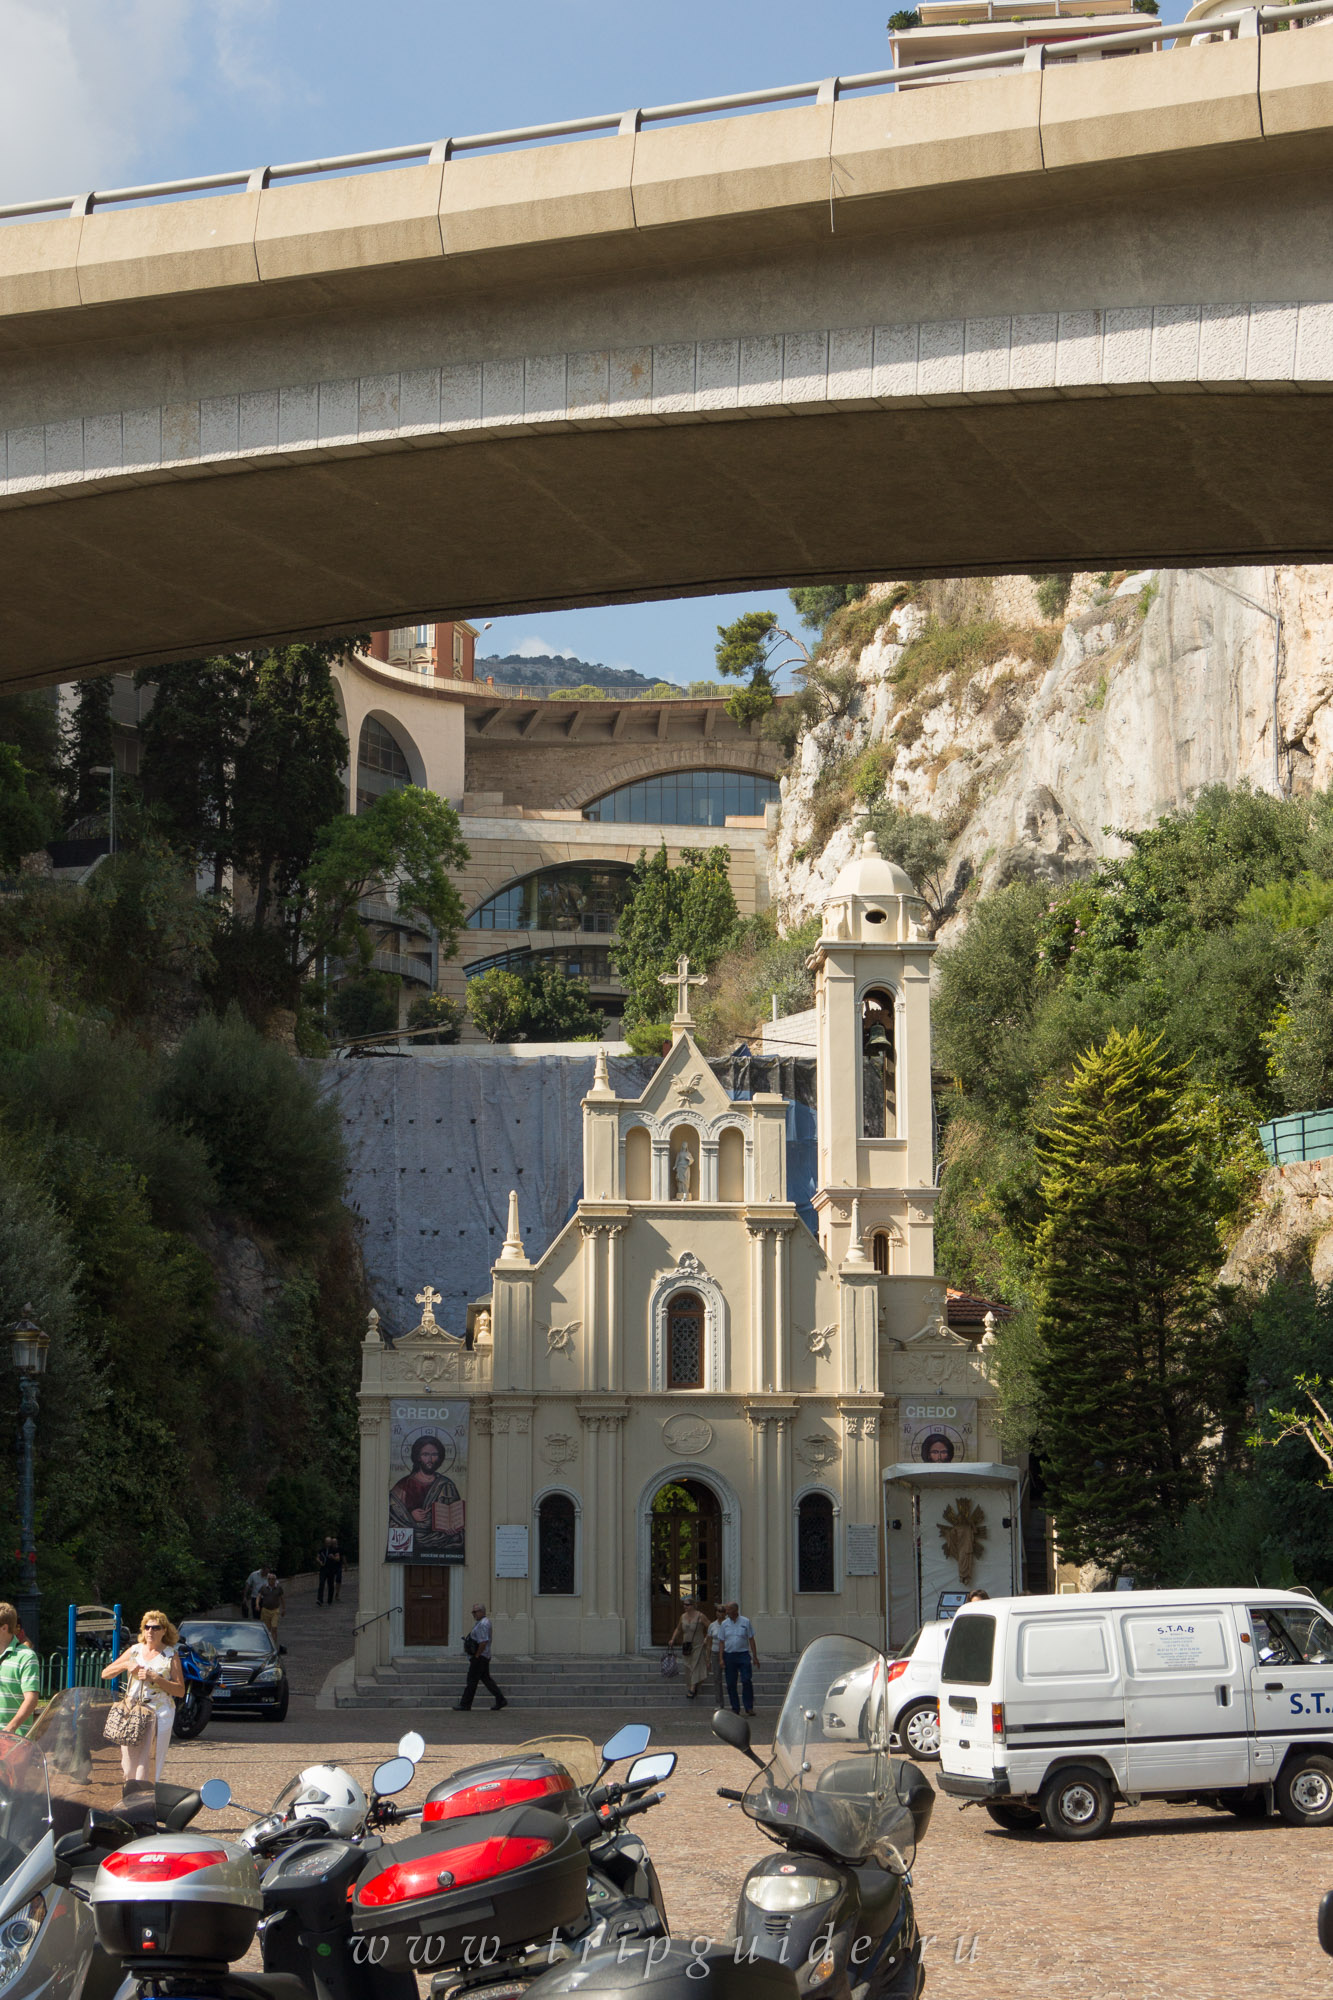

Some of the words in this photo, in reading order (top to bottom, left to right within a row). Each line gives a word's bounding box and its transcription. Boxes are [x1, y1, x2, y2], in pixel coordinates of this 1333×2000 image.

[396, 1407, 449, 1420] CREDO
[905, 1406, 957, 1418] CREDO
[1157, 1625, 1195, 1635] S.T.A.B
[1290, 1692, 1333, 1715] S.T.
